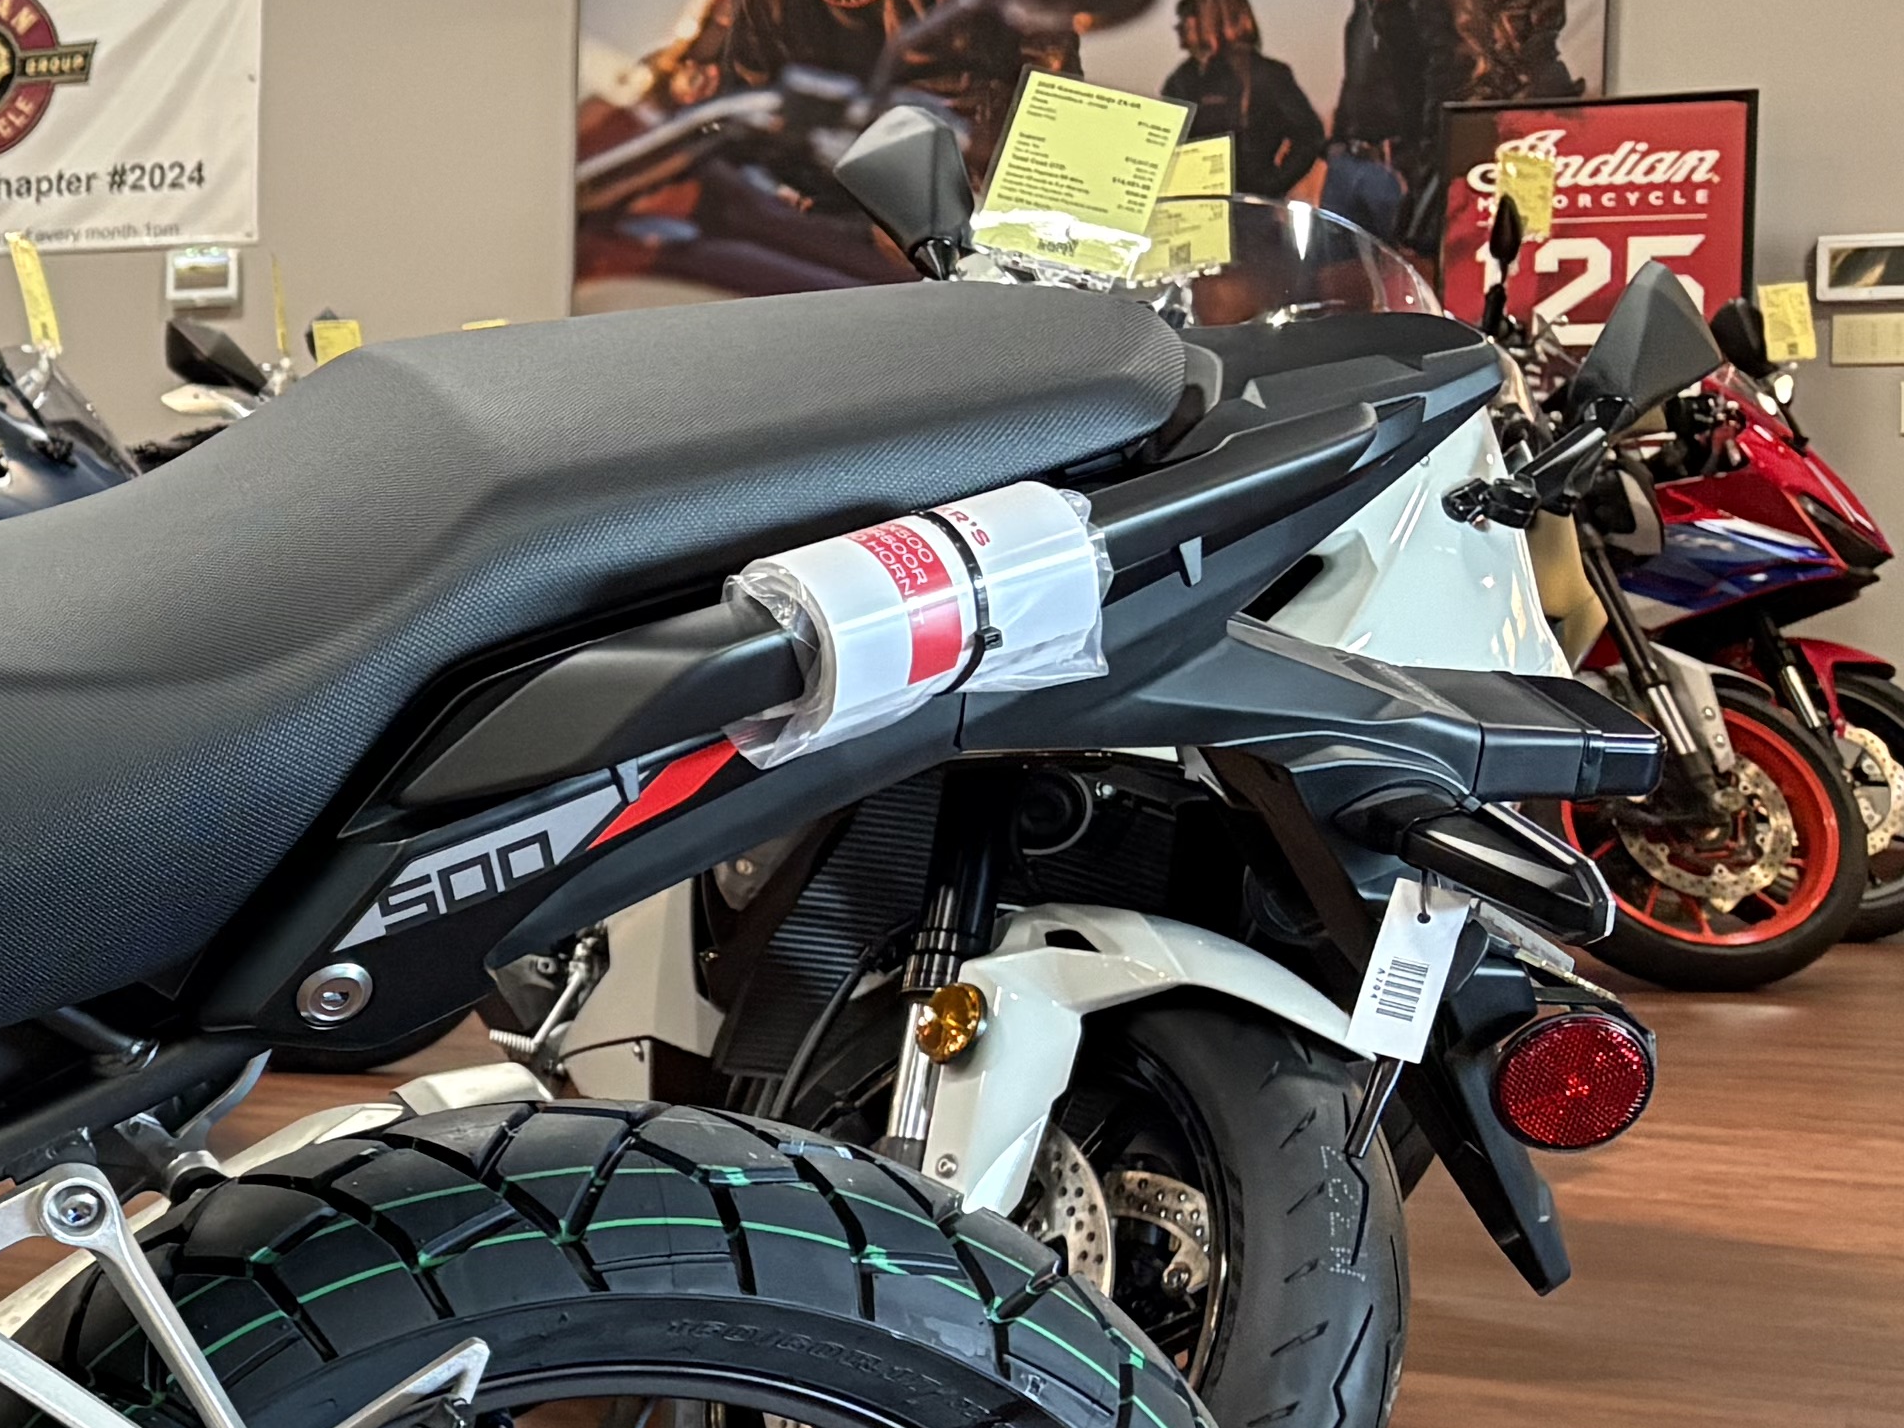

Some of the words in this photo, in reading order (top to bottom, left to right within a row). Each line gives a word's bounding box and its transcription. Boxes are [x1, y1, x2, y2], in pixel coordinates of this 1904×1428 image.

[25, 54, 85, 77] GROUP
[108, 159, 205, 194] #2024
[1477, 189, 1710, 212] MORCYCLE
[37, 227, 80, 243] every
[378, 830, 556, 937] 500
